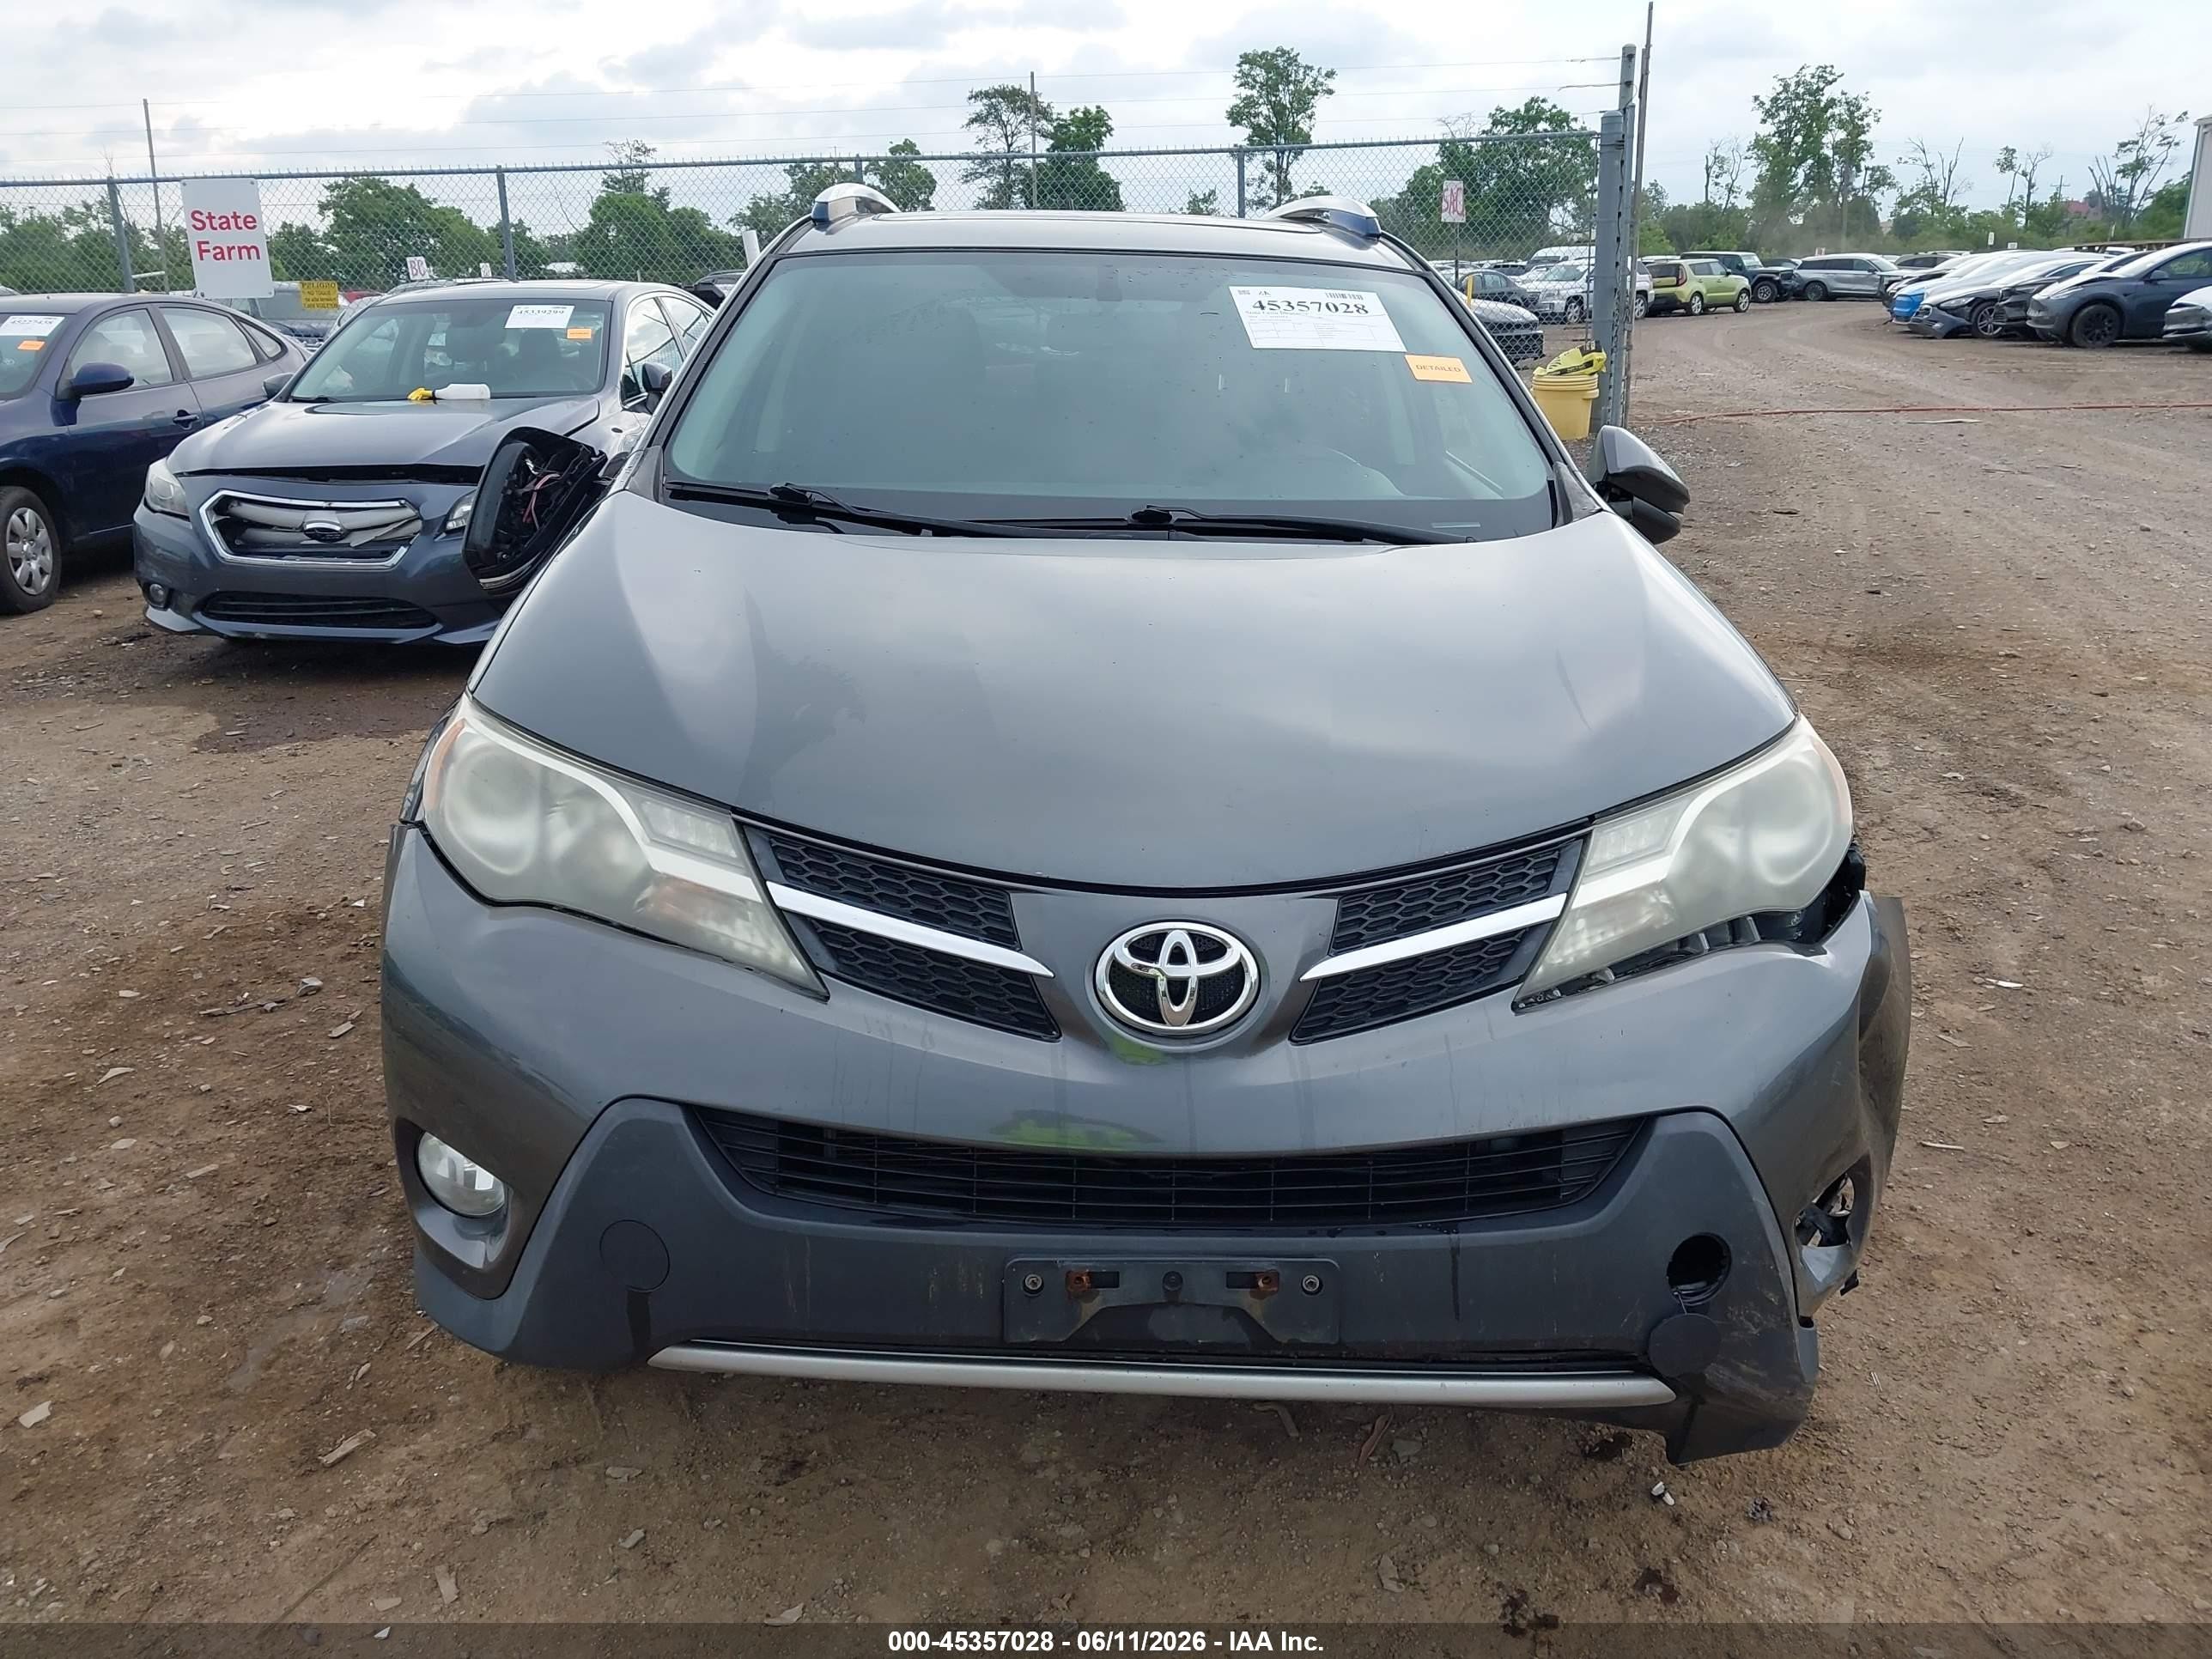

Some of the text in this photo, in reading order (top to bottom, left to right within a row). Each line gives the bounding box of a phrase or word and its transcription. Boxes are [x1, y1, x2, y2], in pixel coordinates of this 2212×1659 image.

[191, 210, 258, 231] State
[197, 240, 261, 261] Farm
[1252, 300, 1369, 314] 45357028
[1415, 364, 1462, 373] DETAILED
